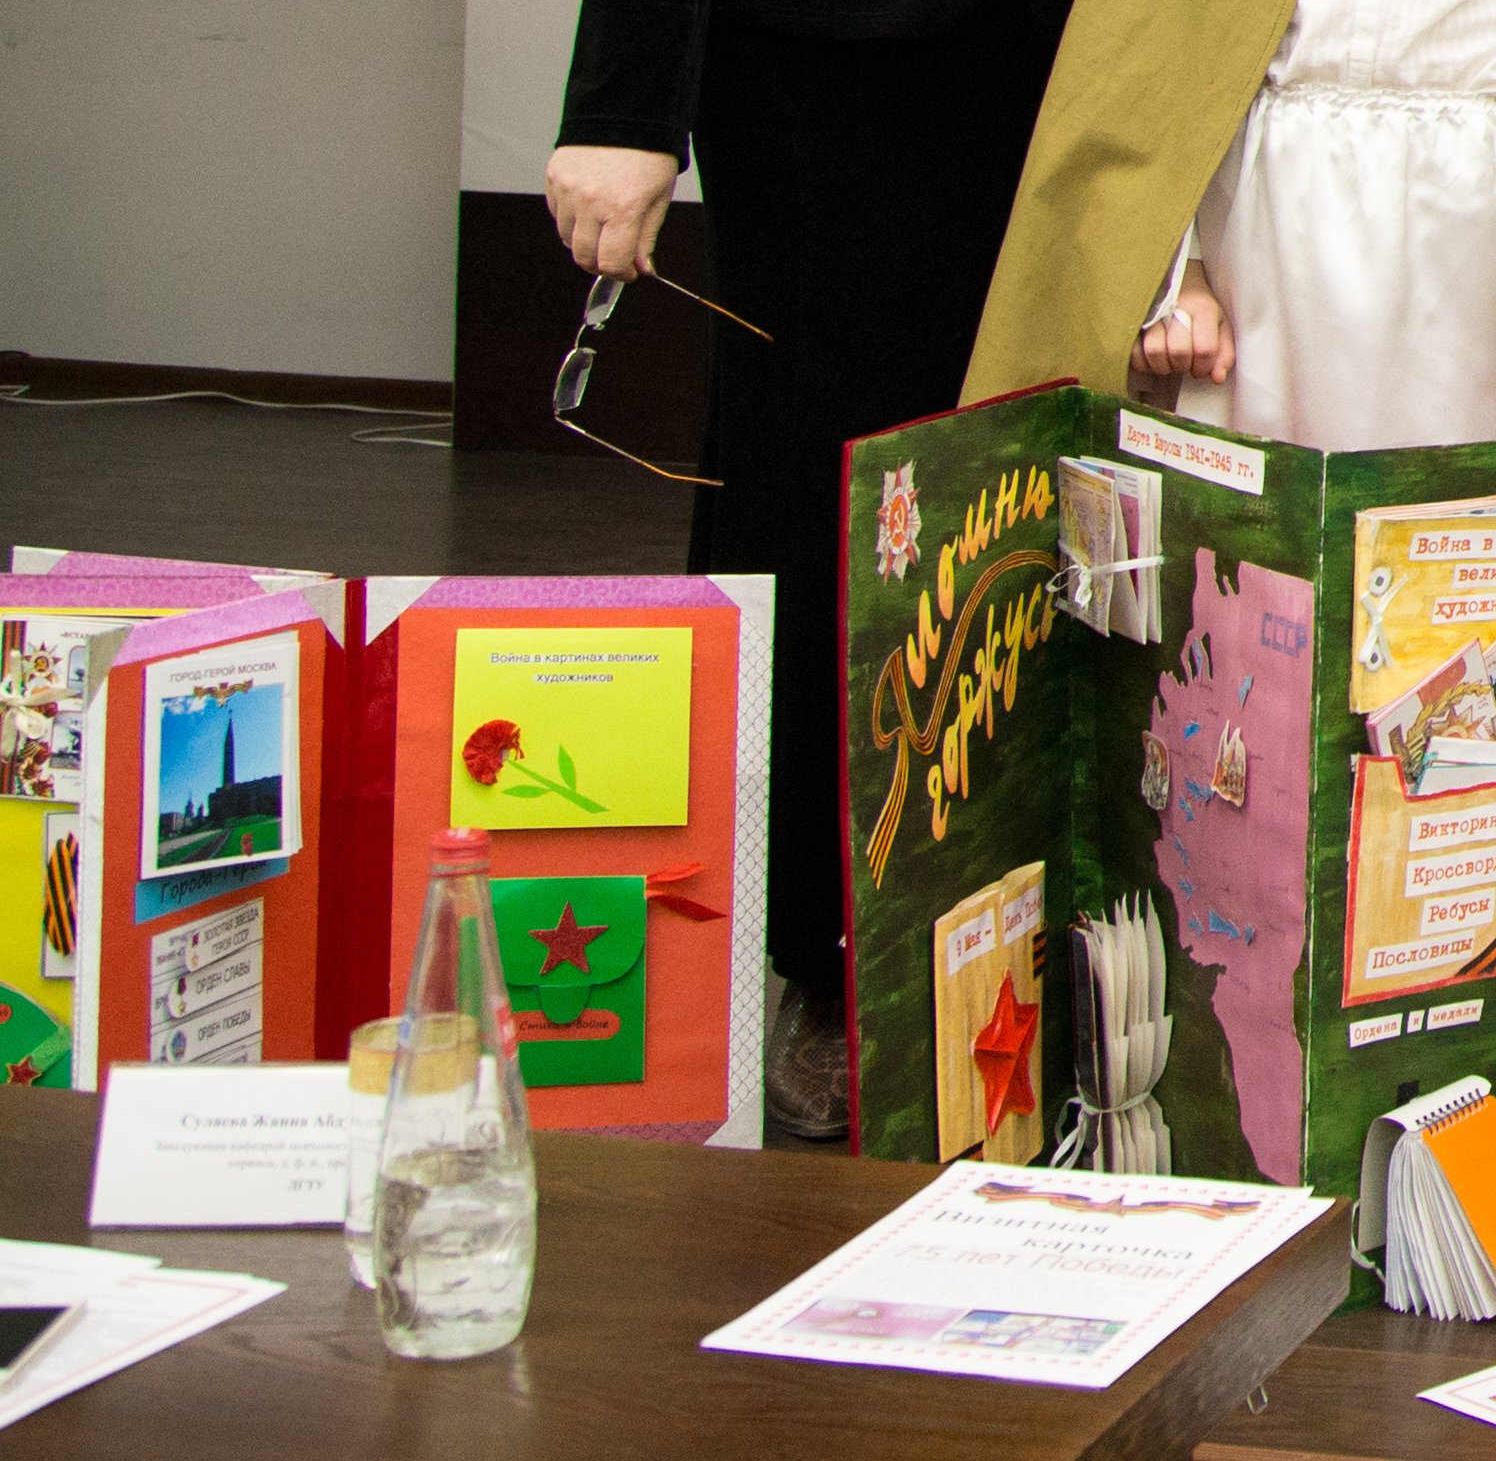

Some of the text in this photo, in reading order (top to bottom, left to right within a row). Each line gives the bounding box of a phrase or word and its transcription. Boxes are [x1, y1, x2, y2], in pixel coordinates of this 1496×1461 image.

[1128, 425, 1150, 447] Карта
[1186, 444, 1232, 472] 1941-1945
[1416, 536, 1471, 555] Война
[1483, 538, 1493, 551] в
[906, 465, 1055, 689] помню
[1261, 612, 1308, 658] СССР
[170, 662, 277, 682] ГОРОД-ГЕРОЙ МОСКВА
[491, 652, 660, 665] Война в картинах великих
[536, 673, 614, 684] художников
[927, 582, 1059, 842] горжусь
[1428, 898, 1490, 923] Ребусы
[1372, 937, 1474, 969] Пословицы
[196, 960, 250, 994] ОРДЕН СЛАВЫ
[198, 1008, 251, 1042] ОРДЕН ПОБЕДЫ
[1354, 1006, 1478, 1041] Ордена и медали
[934, 1209, 1110, 1235] Визитная
[1023, 1238, 1193, 1260] карточка
[1030, 1253, 1185, 1280] Победы
